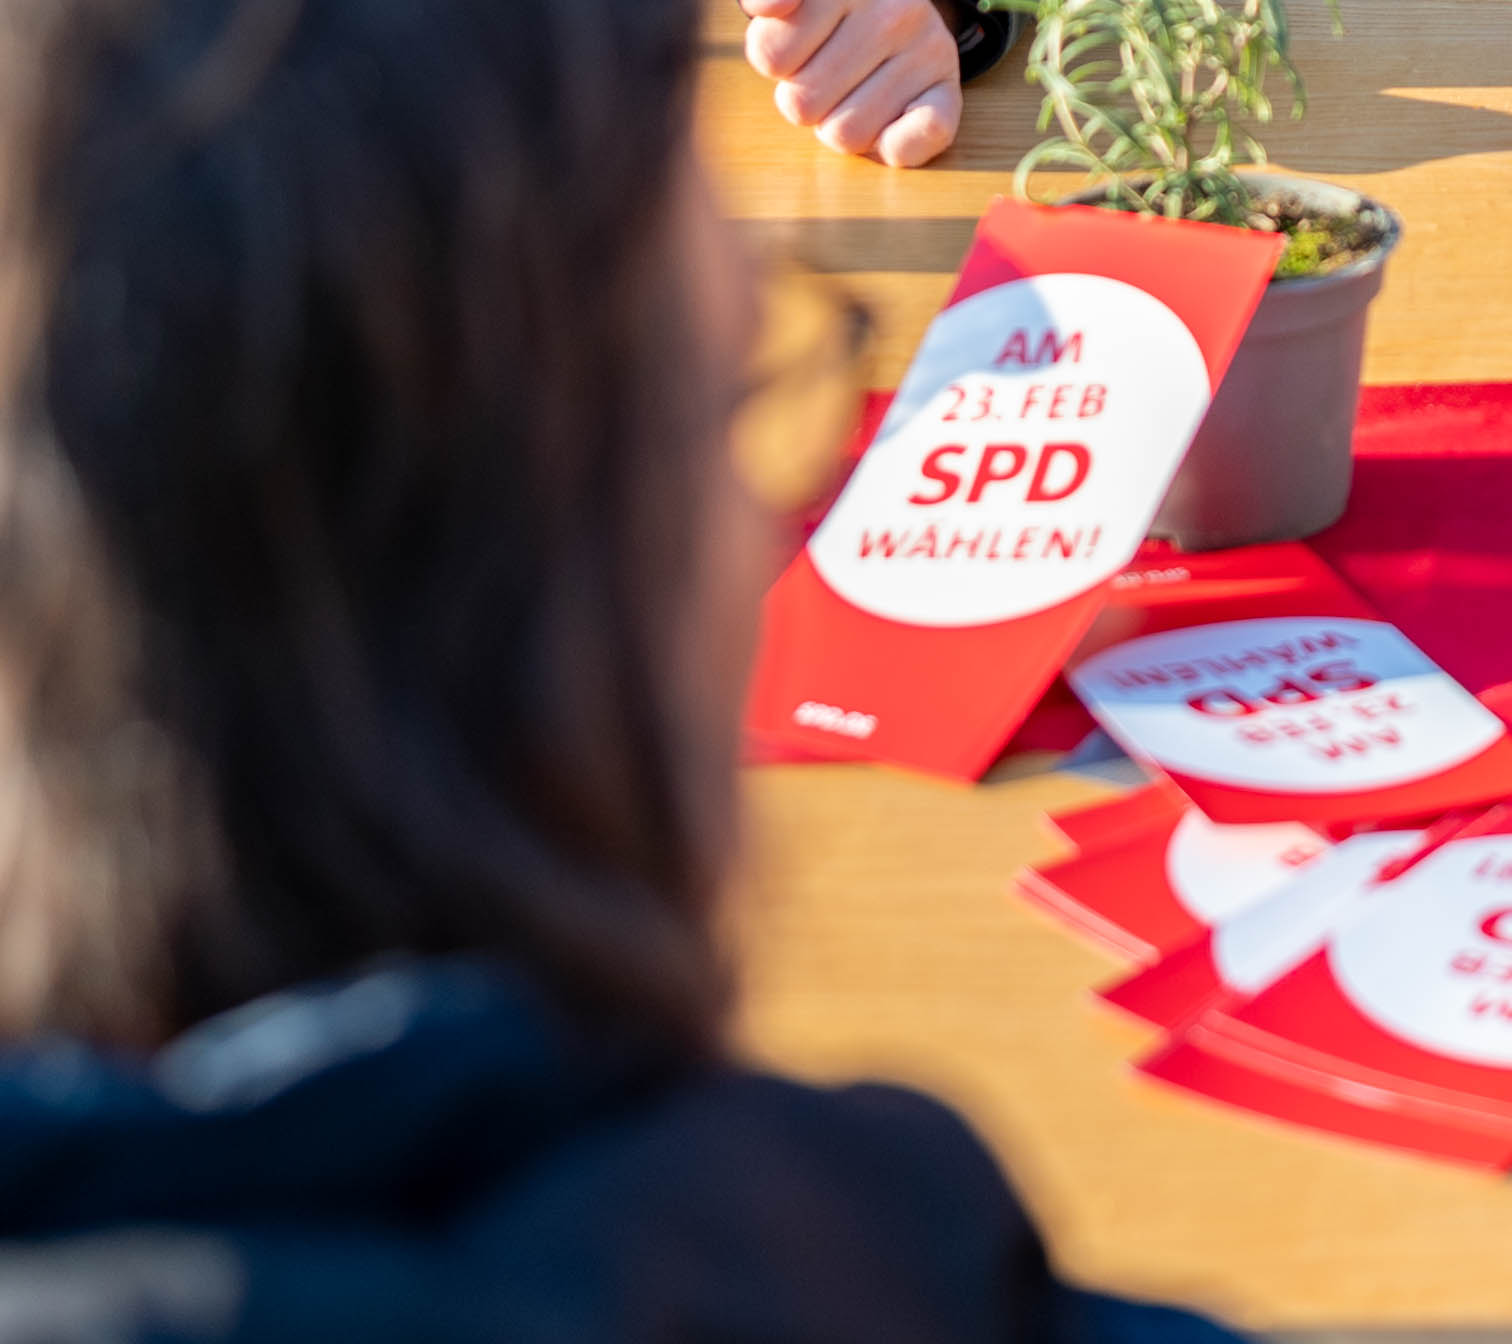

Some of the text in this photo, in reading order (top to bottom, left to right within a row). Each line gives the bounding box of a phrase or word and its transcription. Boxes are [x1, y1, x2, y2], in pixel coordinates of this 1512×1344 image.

[993, 325, 1085, 368] AM
[941, 382, 1109, 423] 23. FEB
[907, 441, 1094, 507] SPD
[857, 520, 1104, 562] WÄHLEN!
[1186, 659, 1380, 718] SPD
